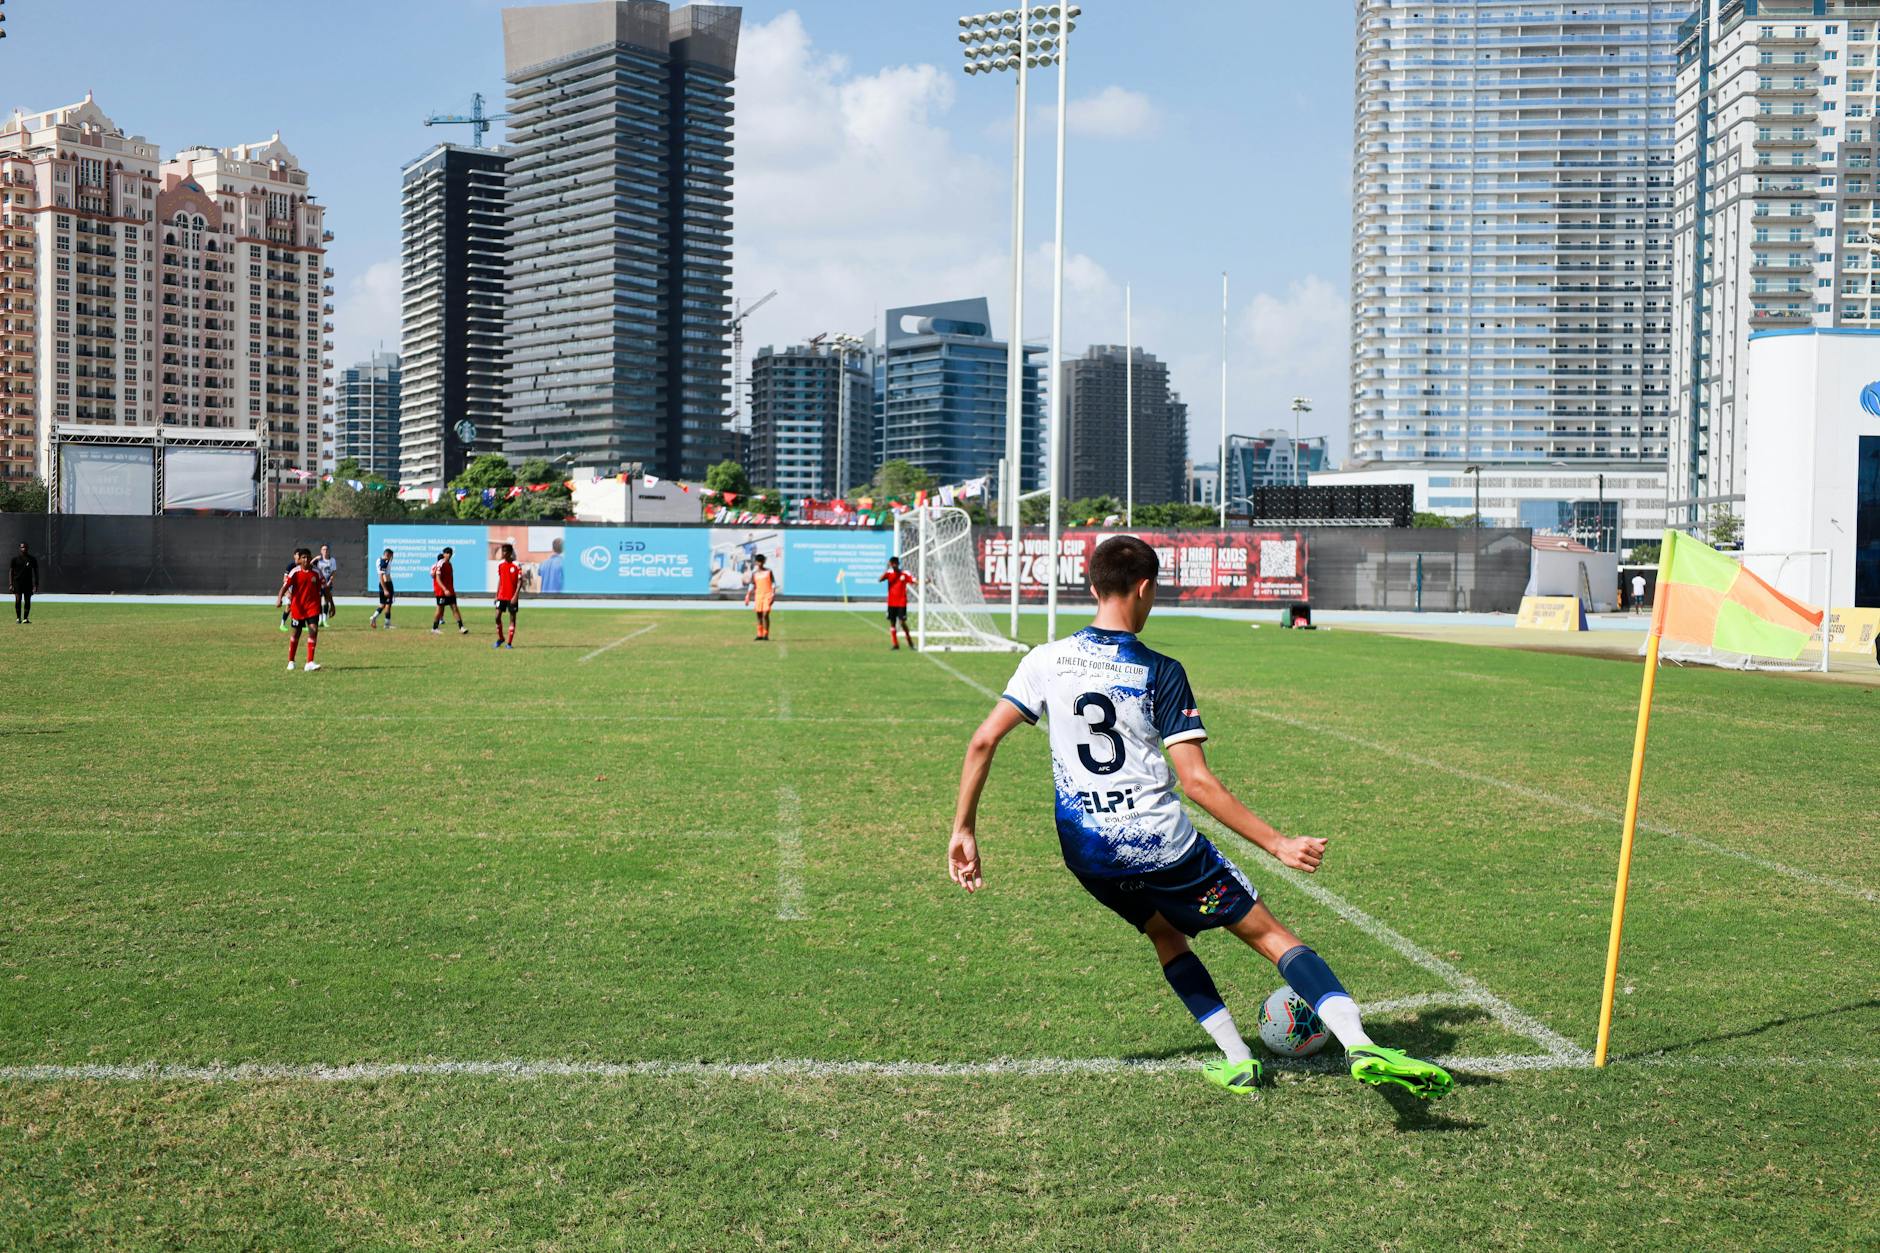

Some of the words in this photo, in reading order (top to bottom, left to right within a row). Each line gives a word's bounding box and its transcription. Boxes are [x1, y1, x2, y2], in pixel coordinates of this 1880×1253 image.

[1024, 539, 1062, 555] WORD
[1063, 539, 1085, 555] CUP
[1179, 547, 1187, 561] 3
[1188, 547, 1212, 561] HIGH
[618, 553, 689, 565] SPORTS
[1218, 547, 1248, 562] KIDS
[618, 566, 694, 577] SCIENCE
[1217, 575, 1232, 586] POP
[1056, 656, 1087, 668] ATHLETIC
[1089, 660, 1122, 673] FOOTBALL
[1124, 665, 1144, 675] CLUB
[1073, 692, 1126, 775] 3
